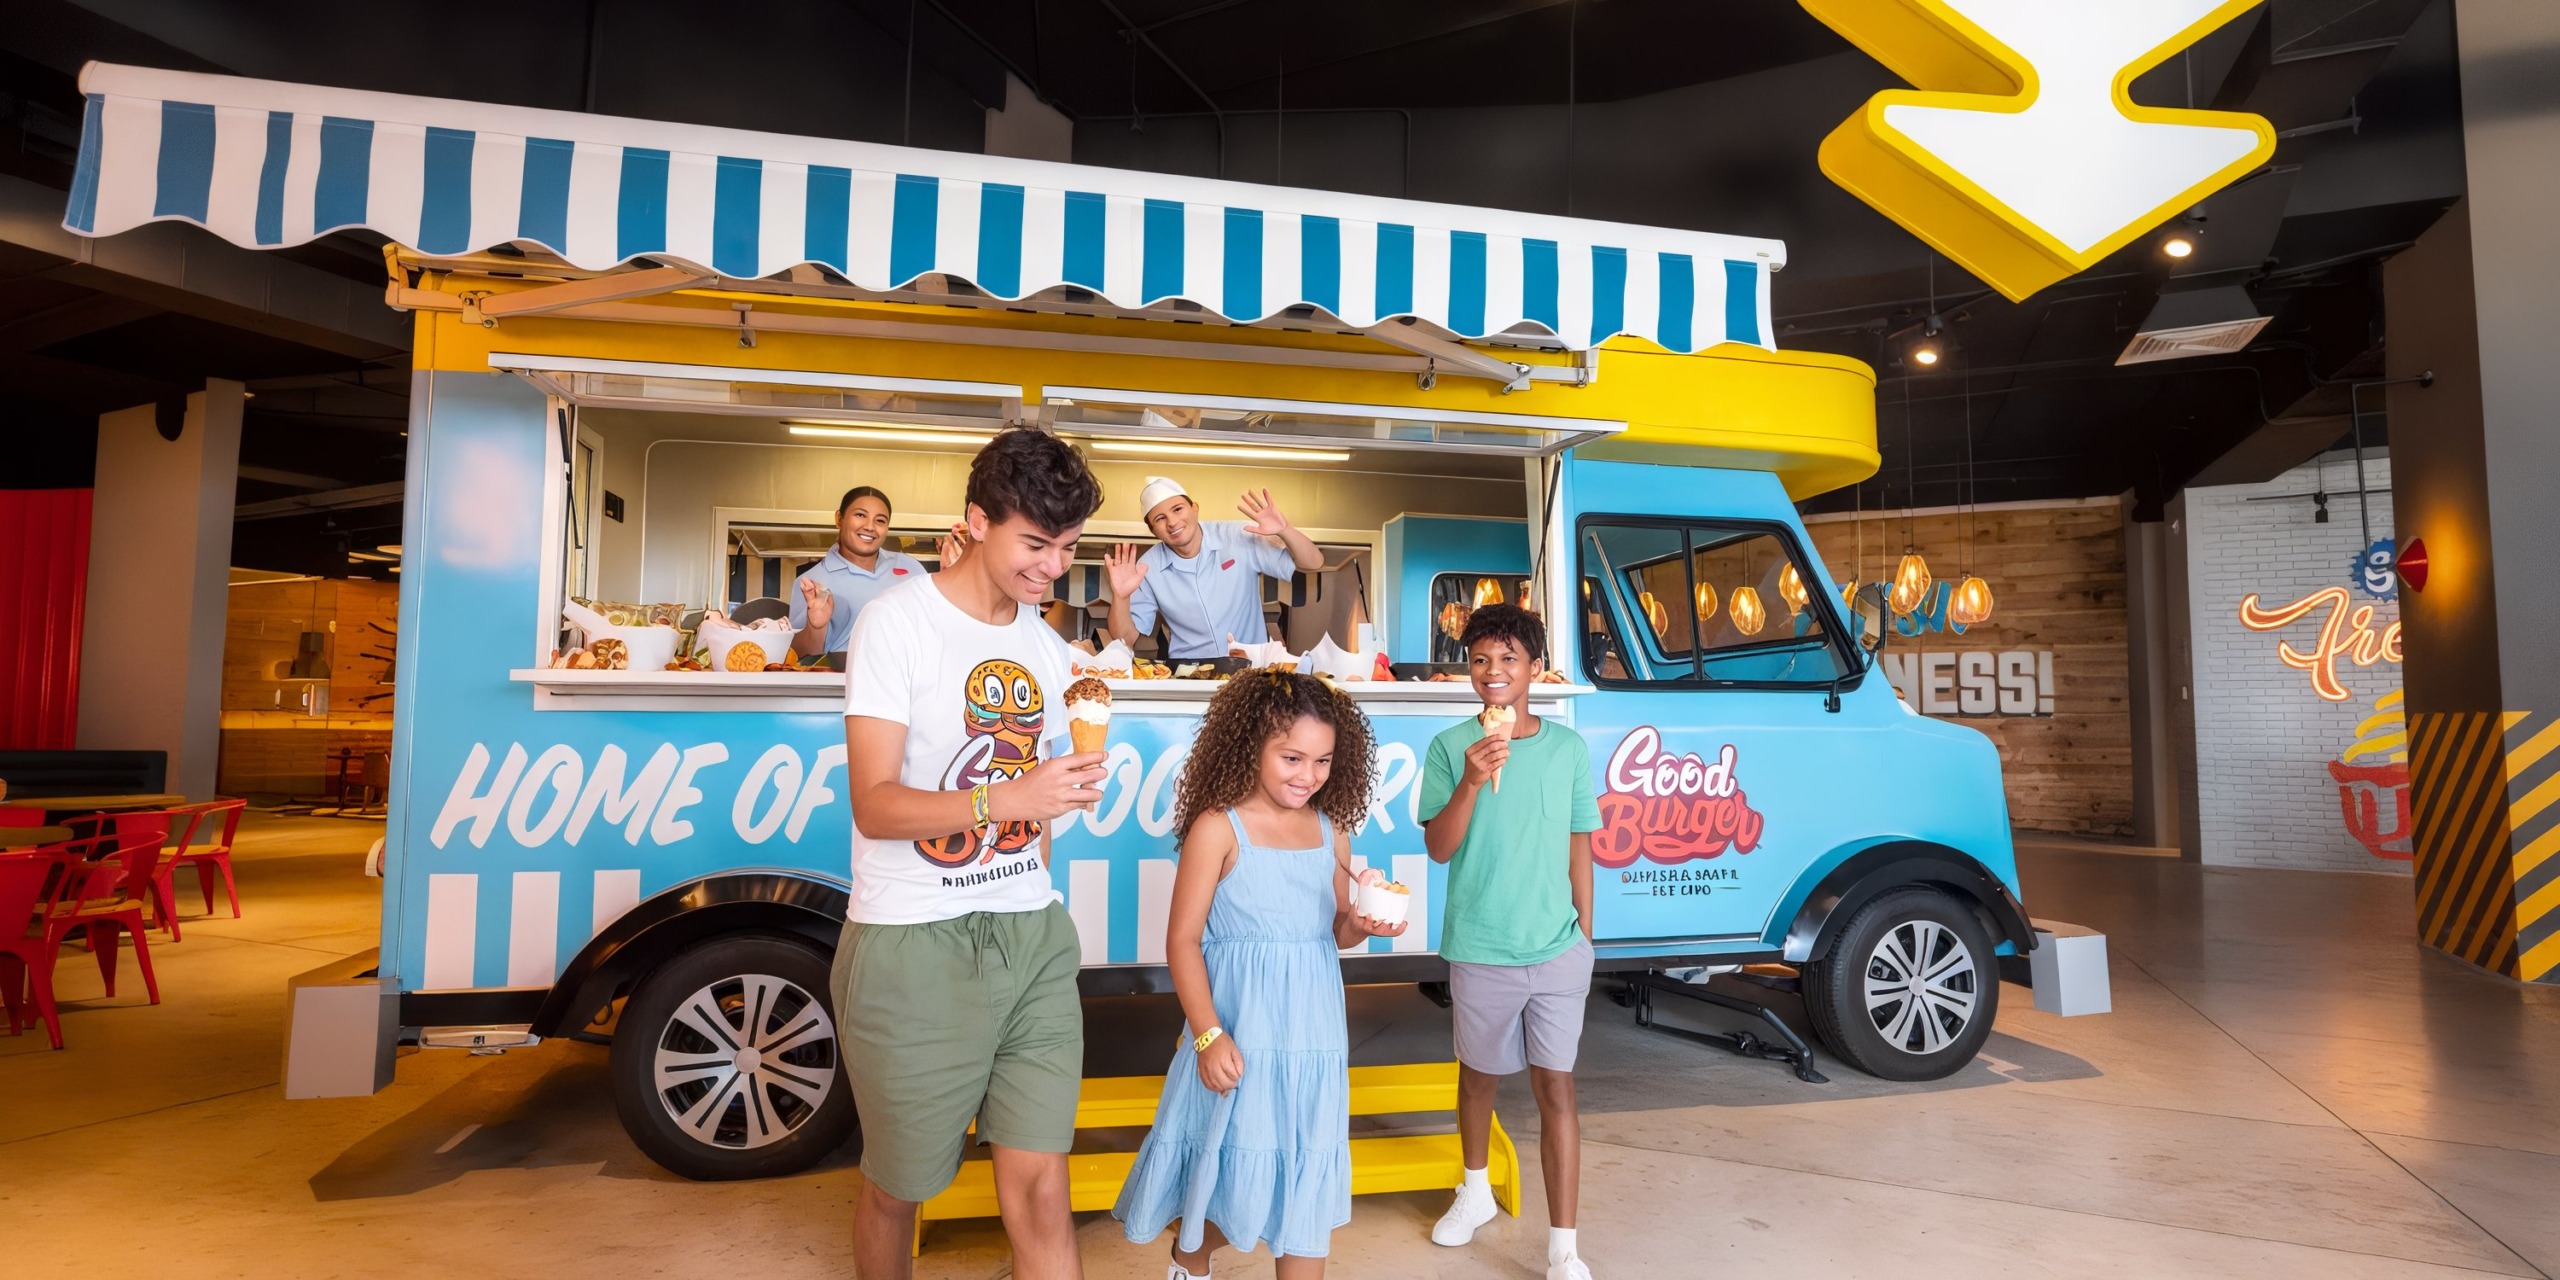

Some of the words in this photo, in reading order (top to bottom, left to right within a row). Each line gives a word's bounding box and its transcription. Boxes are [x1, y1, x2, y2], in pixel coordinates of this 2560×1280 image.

[430, 741, 729, 849] HOME
[732, 743, 848, 843] OF
[1605, 725, 1738, 798] Good
